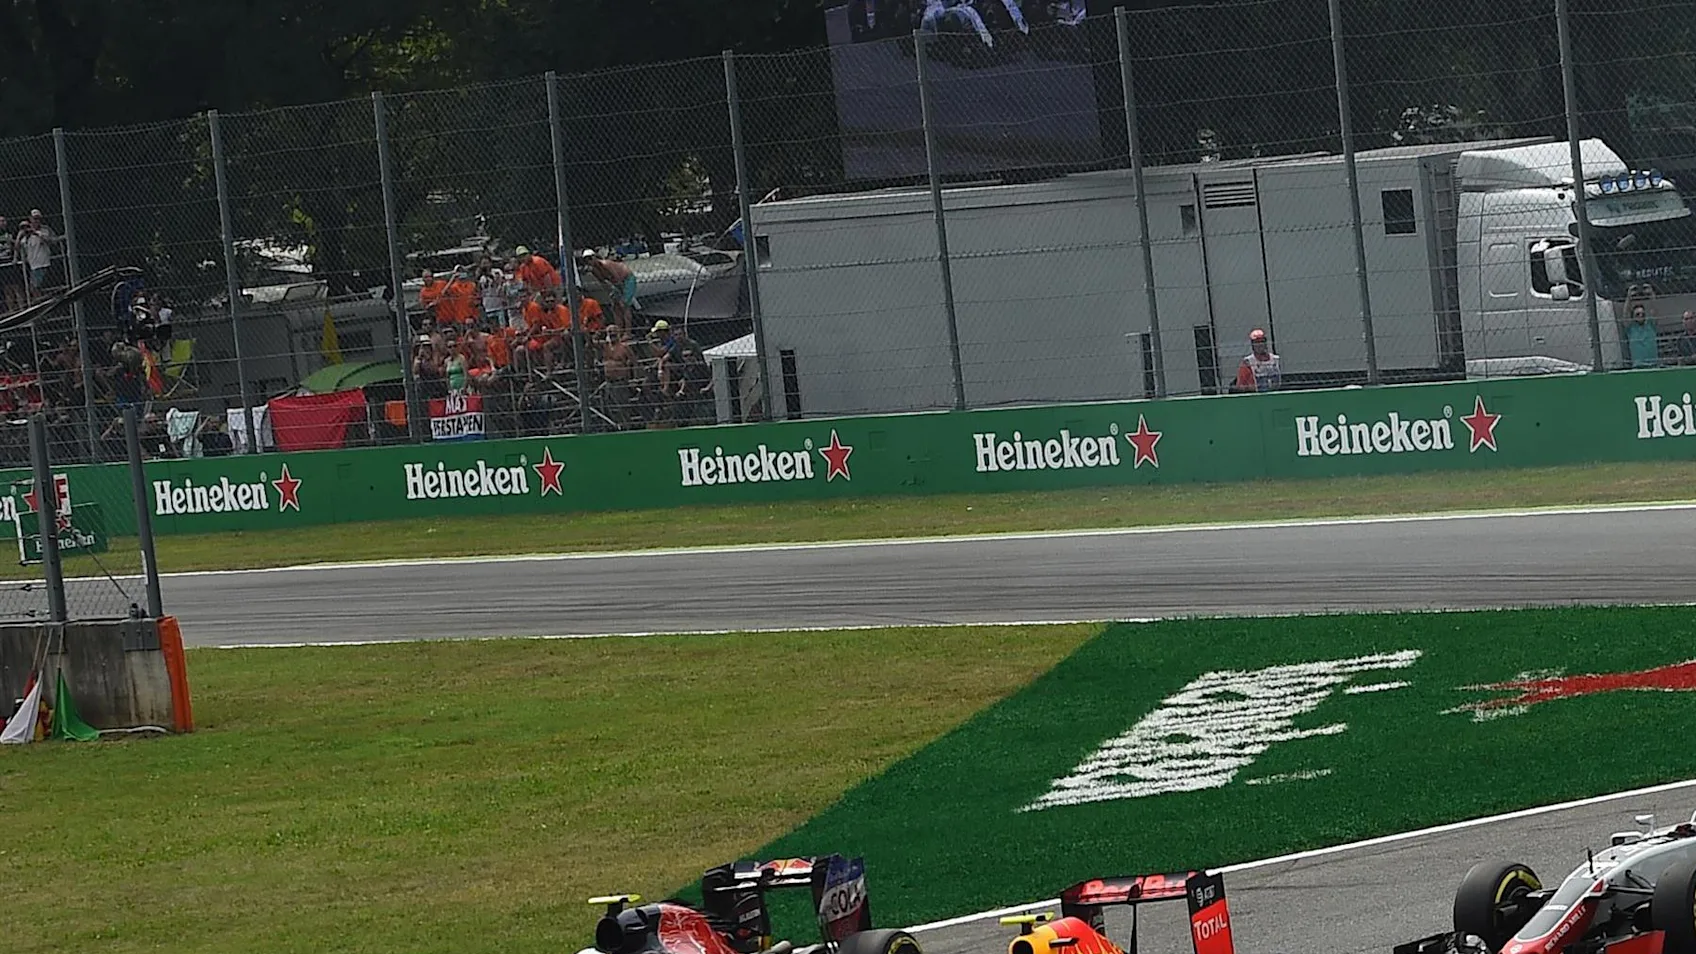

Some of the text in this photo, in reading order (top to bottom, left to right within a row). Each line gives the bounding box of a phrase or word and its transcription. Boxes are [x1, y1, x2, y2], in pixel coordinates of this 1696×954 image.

[973, 430, 1120, 471] Heineken
[1296, 413, 1454, 455] Heineken
[404, 461, 529, 499] Heineken
[678, 445, 810, 485] Heineken
[153, 477, 268, 514] Heineken
[1194, 913, 1228, 941] TOTAL
